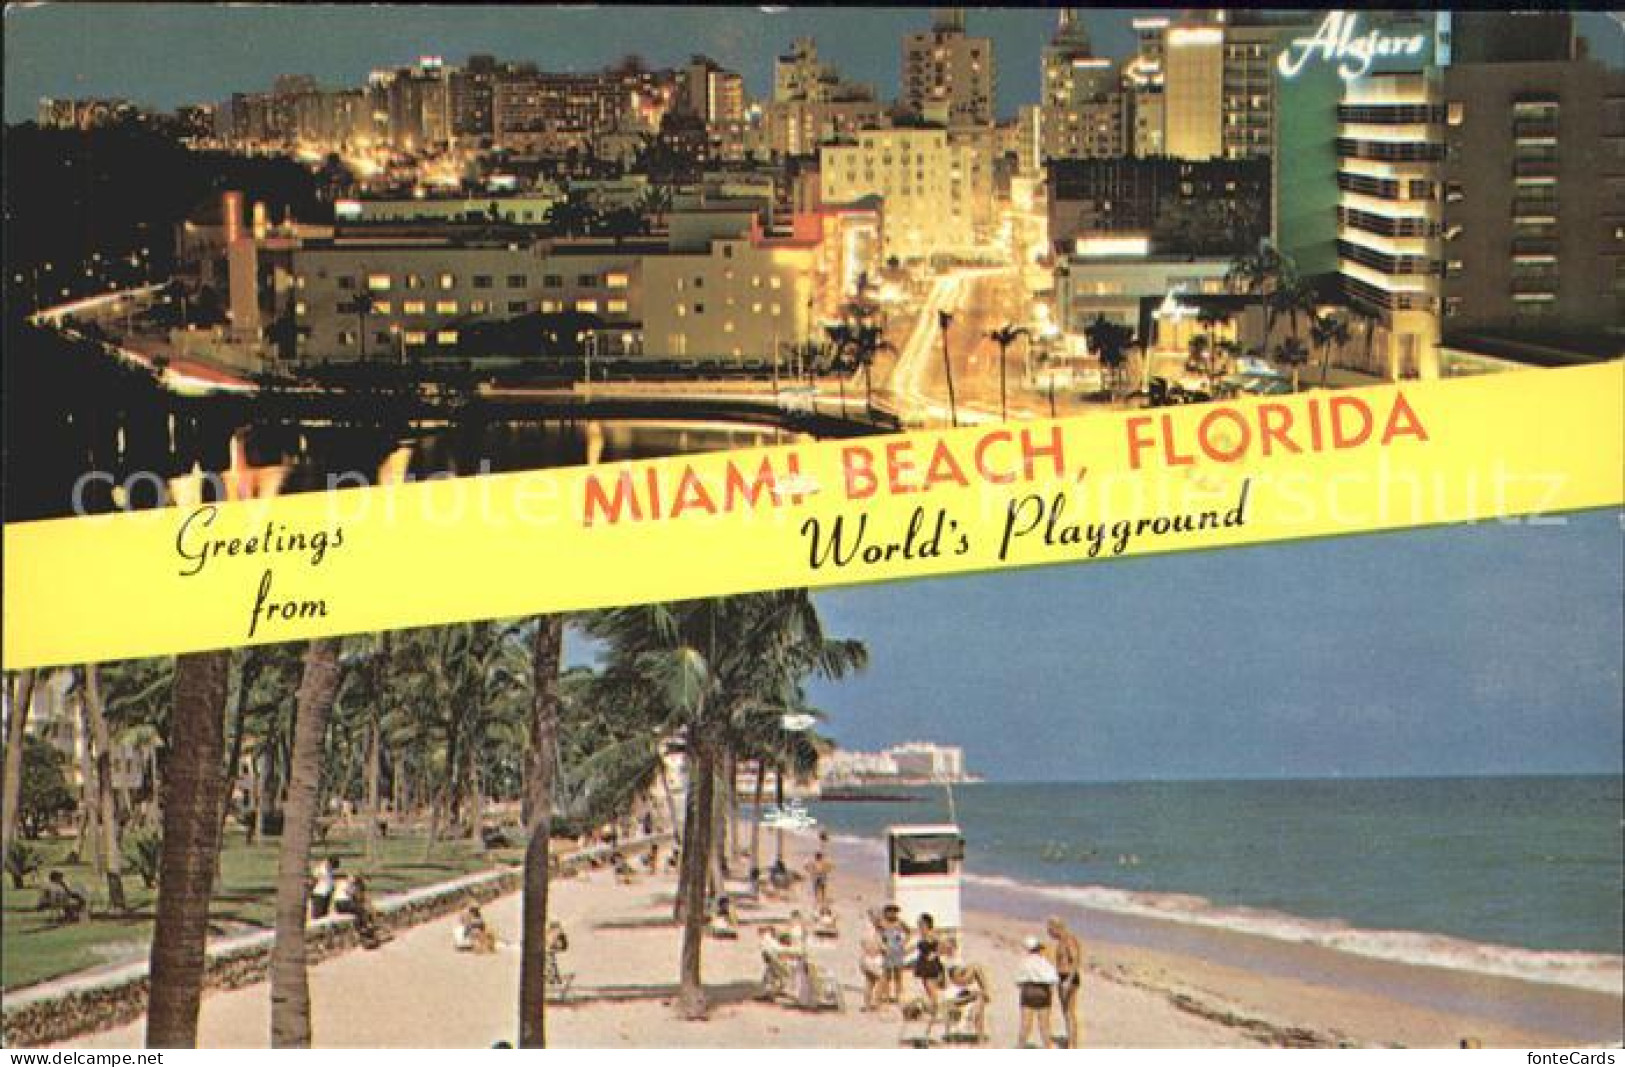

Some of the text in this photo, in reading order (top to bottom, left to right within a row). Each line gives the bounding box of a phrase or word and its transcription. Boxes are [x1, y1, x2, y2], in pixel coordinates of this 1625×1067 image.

[583, 391, 1429, 528] MIAMI BEACH, FLORIDA
[176, 505, 344, 577] Greetings
[800, 477, 1250, 570] World's Playground
[248, 568, 328, 638] from
